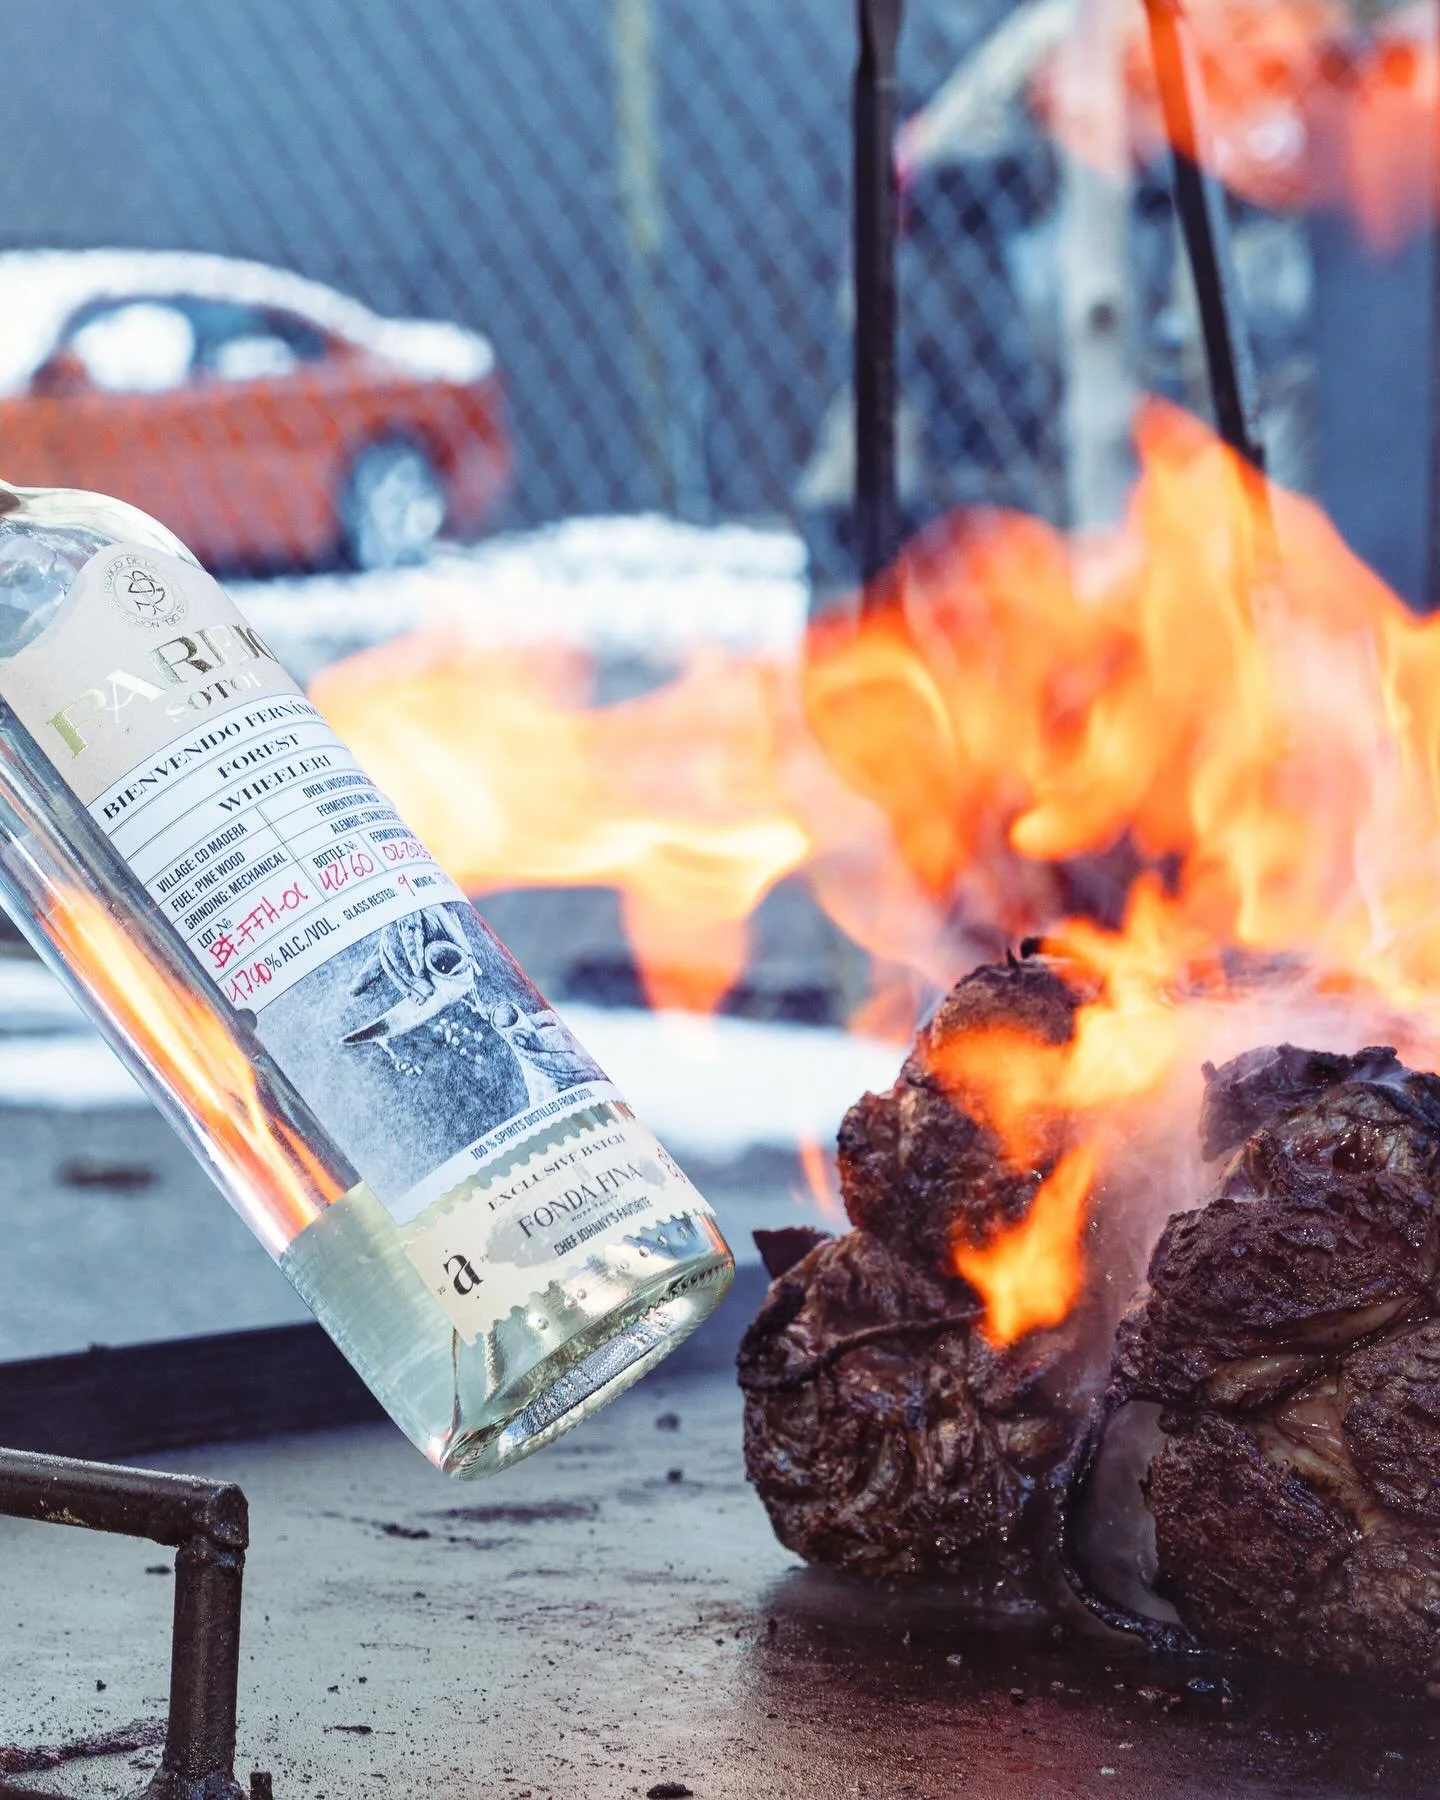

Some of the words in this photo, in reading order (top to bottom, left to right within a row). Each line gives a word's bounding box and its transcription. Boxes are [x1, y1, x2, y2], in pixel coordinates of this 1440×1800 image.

[102, 722, 241, 820] BIENVENIDO
[217, 733, 300, 779] FOREST
[218, 755, 332, 812] WHEELERI
[302, 782, 328, 799] OVEN:
[330, 814, 365, 835] ALEMBIC:
[156, 858, 198, 894] VILLAGE:
[194, 848, 210, 865] CD
[207, 823, 248, 855] MADERA
[171, 888, 199, 913] FUEL:
[194, 870, 219, 894] PINE
[215, 851, 246, 876] WOOD
[313, 844, 346, 869] BOTTLE
[184, 890, 232, 930] GRINDING:
[228, 851, 288, 895] MECHANICAL
[343, 900, 370, 920] GLASS
[197, 928, 217, 949] LOT
[279, 917, 340, 963] ALC./VOL.
[470, 1144, 488, 1160] 100
[494, 1120, 526, 1144] SPIRITS
[524, 1101, 560, 1127] DISTILLED
[488, 1149, 581, 1211] EXCLUSIVE
[582, 1133, 626, 1157] BATCH
[517, 1184, 597, 1239] FONDA
[596, 1163, 643, 1193] FINA
[553, 1234, 577, 1256] CHEF
[576, 1212, 620, 1242] JOHNNY'S
